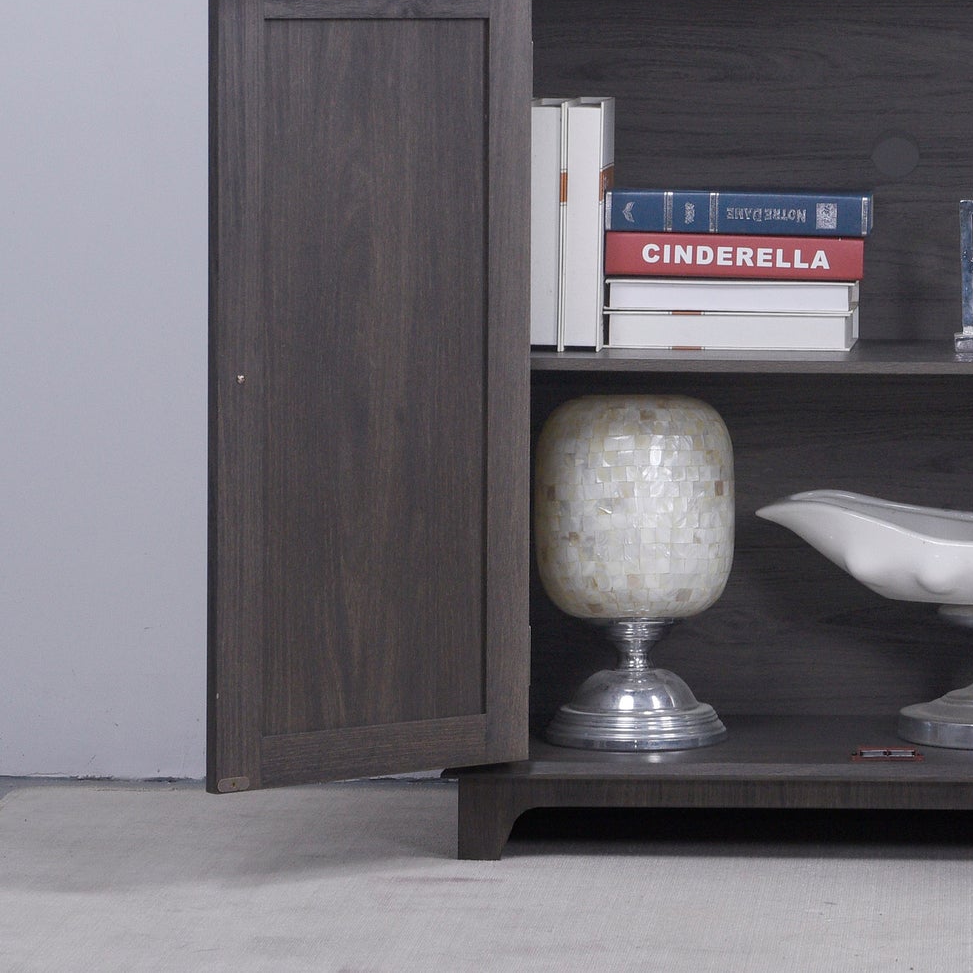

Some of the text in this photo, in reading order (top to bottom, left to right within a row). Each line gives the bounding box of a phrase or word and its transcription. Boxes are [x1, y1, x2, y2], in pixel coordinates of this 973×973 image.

[726, 207, 806, 223] NOTRE DAME
[642, 244, 830, 270] CINDERELLA
